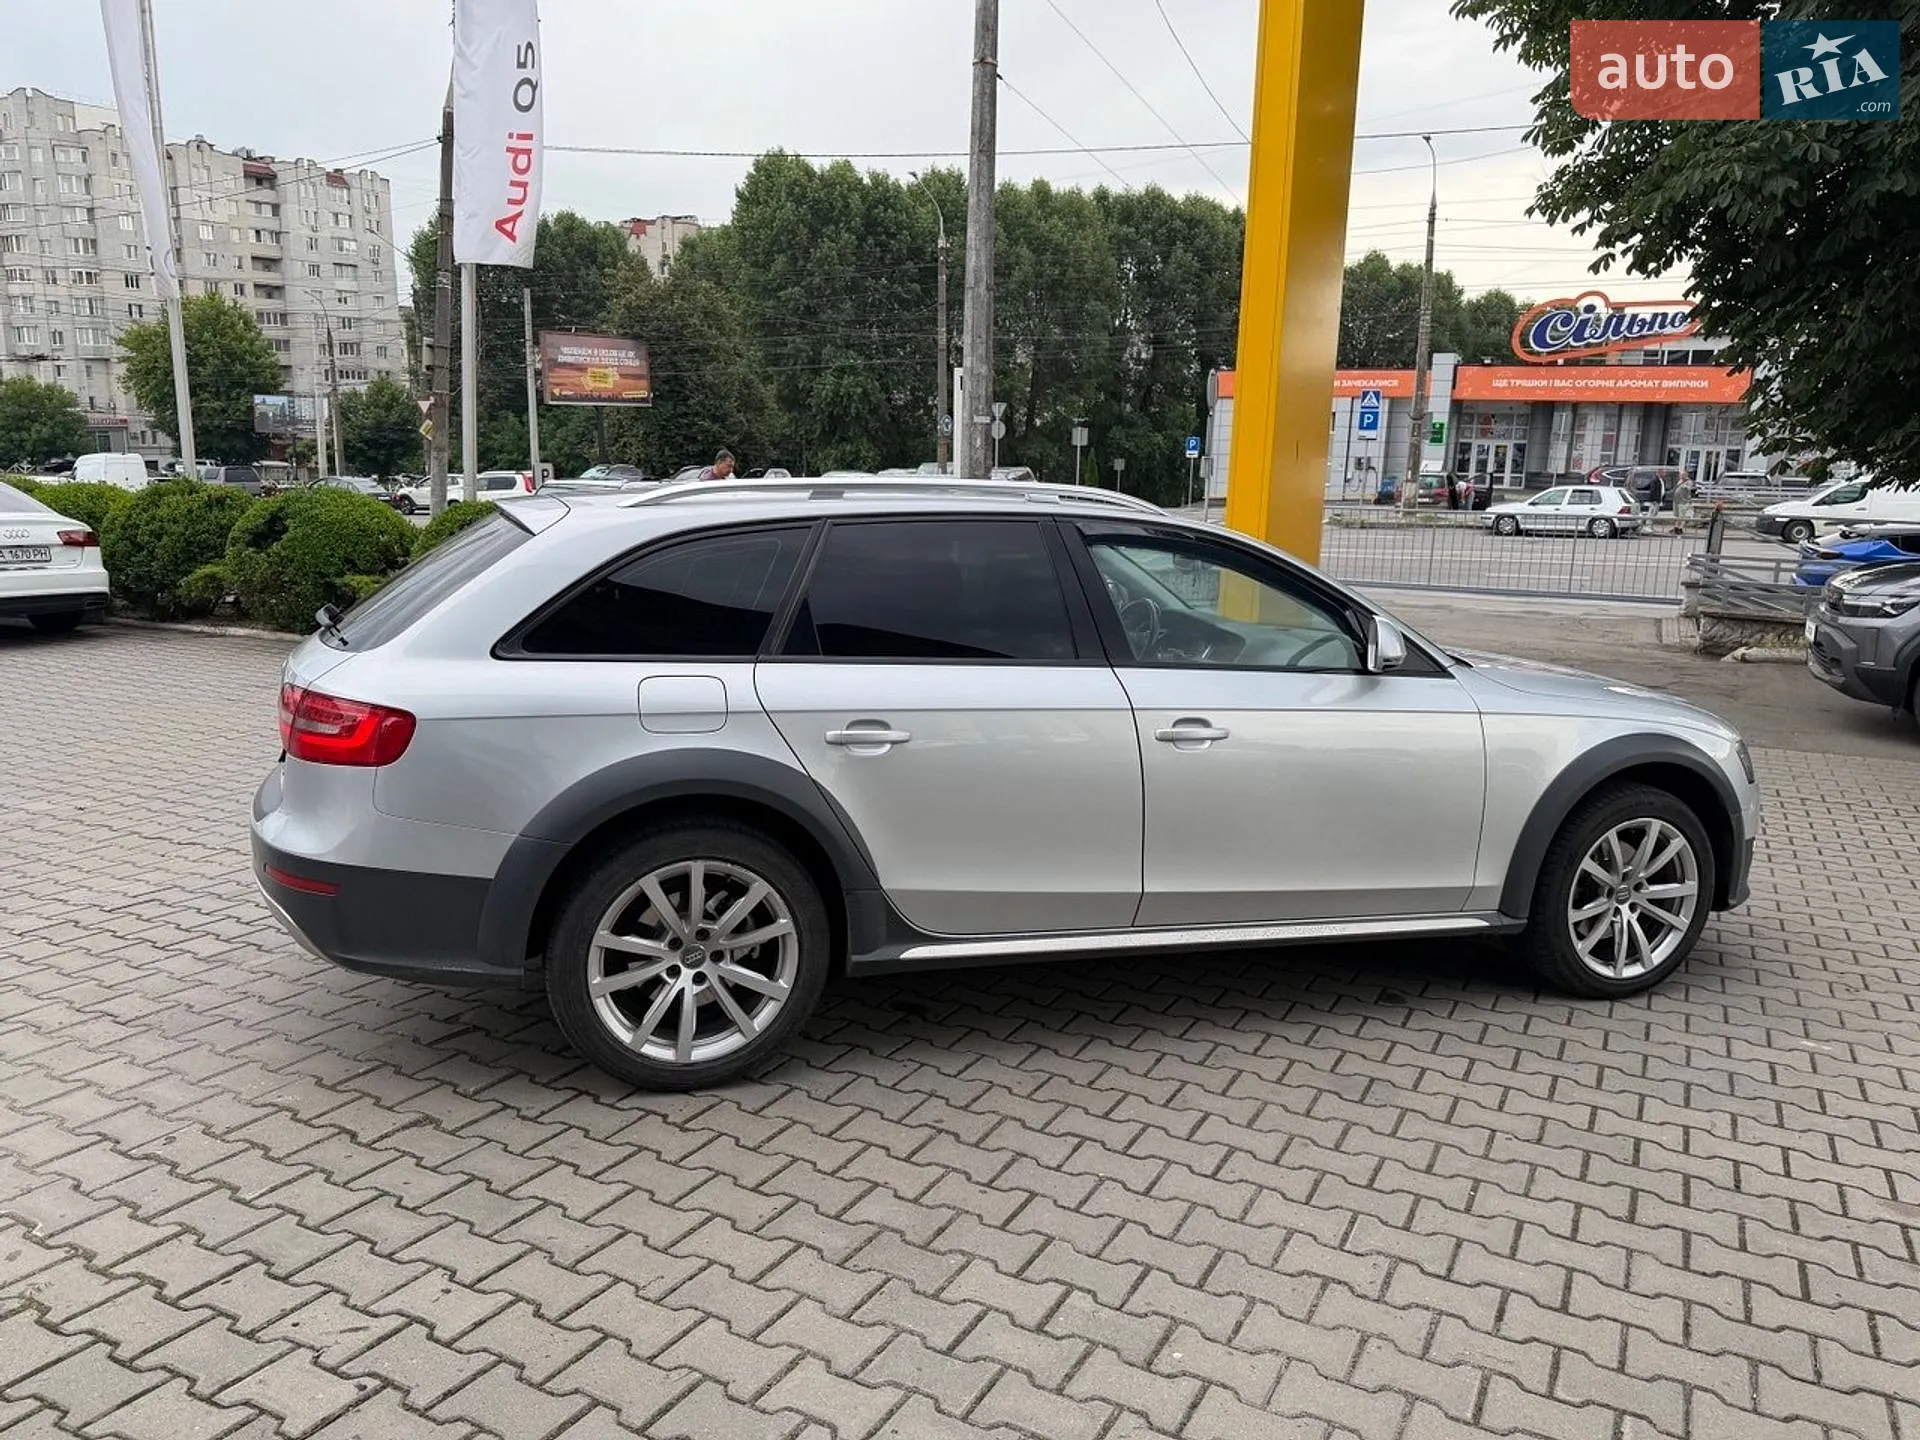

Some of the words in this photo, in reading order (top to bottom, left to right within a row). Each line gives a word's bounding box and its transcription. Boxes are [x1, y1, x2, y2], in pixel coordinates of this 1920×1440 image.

[512, 40, 539, 114] Q5
[494, 132, 535, 244] Audi
[1531, 303, 1691, 350] Сільпо
[1553, 378, 1573, 388] ВАС
[1616, 379, 1660, 389] АРОМАТ
[1364, 414, 1374, 427] P
[1190, 440, 1196, 449] P
[542, 468, 550, 484] P
